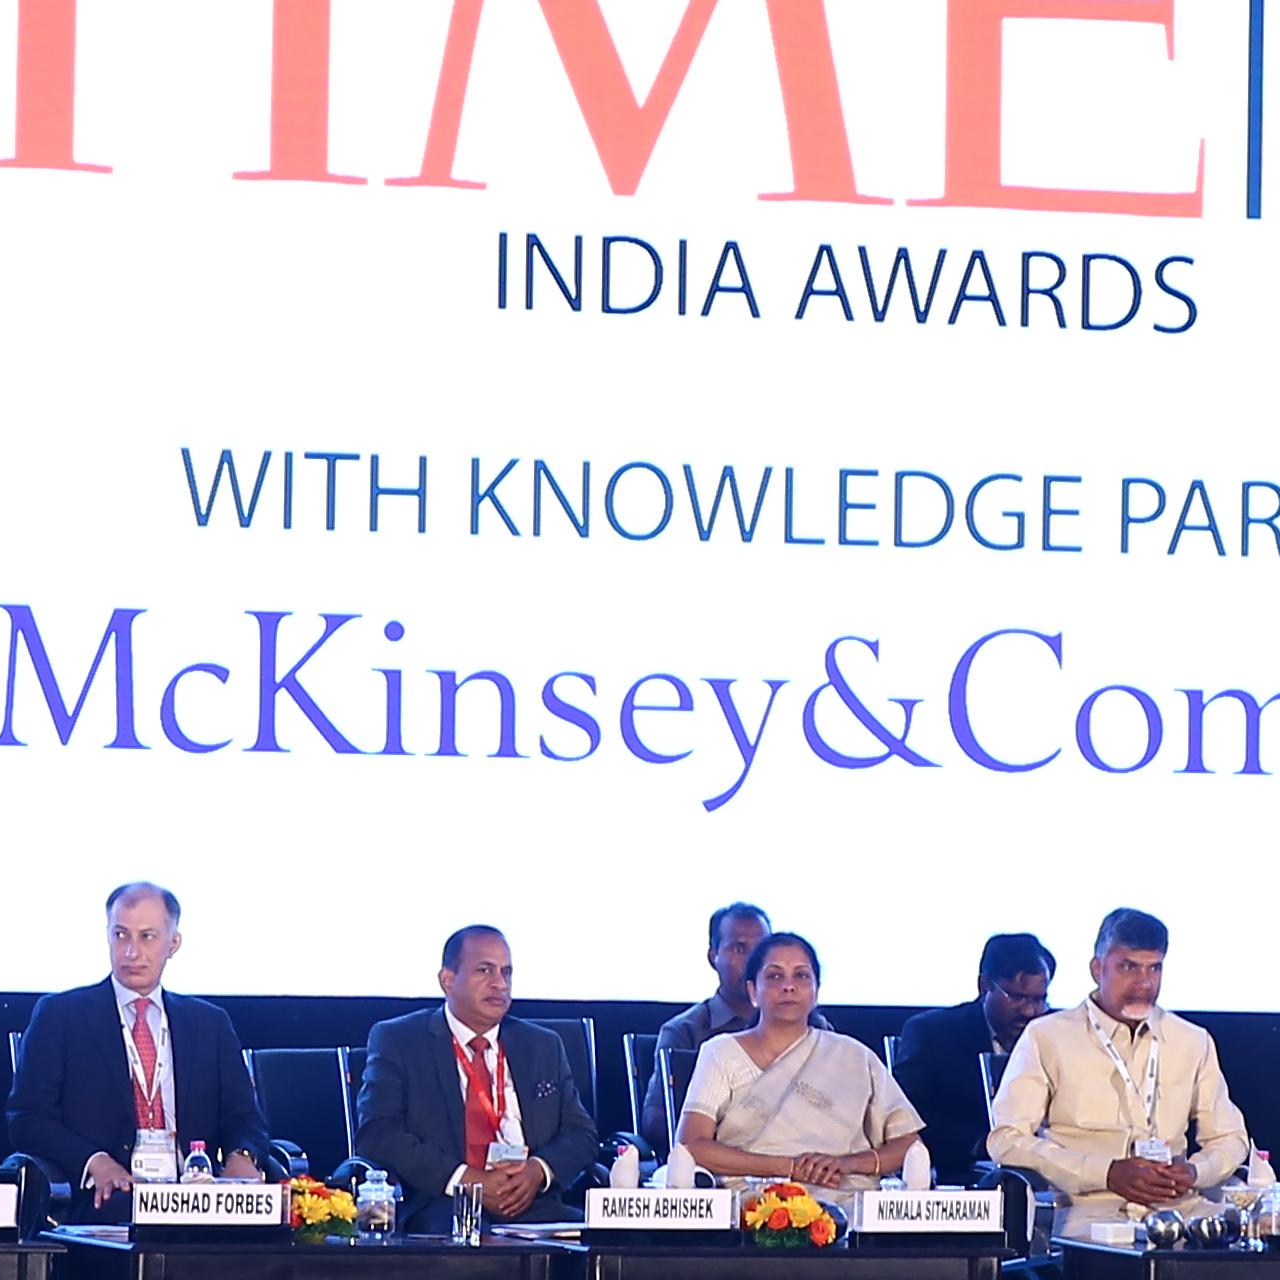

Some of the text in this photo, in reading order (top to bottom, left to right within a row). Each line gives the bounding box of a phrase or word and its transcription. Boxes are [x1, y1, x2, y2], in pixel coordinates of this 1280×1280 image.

[498, 232, 1197, 333] INDIA AWARDS
[181, 447, 427, 534] WITH
[471, 458, 1082, 552] KNOWLEDGE
[138, 1191, 274, 1215] NAUSHAD FORBES
[601, 1196, 714, 1219] RAMESH ABHISHEK
[877, 1200, 991, 1221] NIRMALA SITHARAMAN
